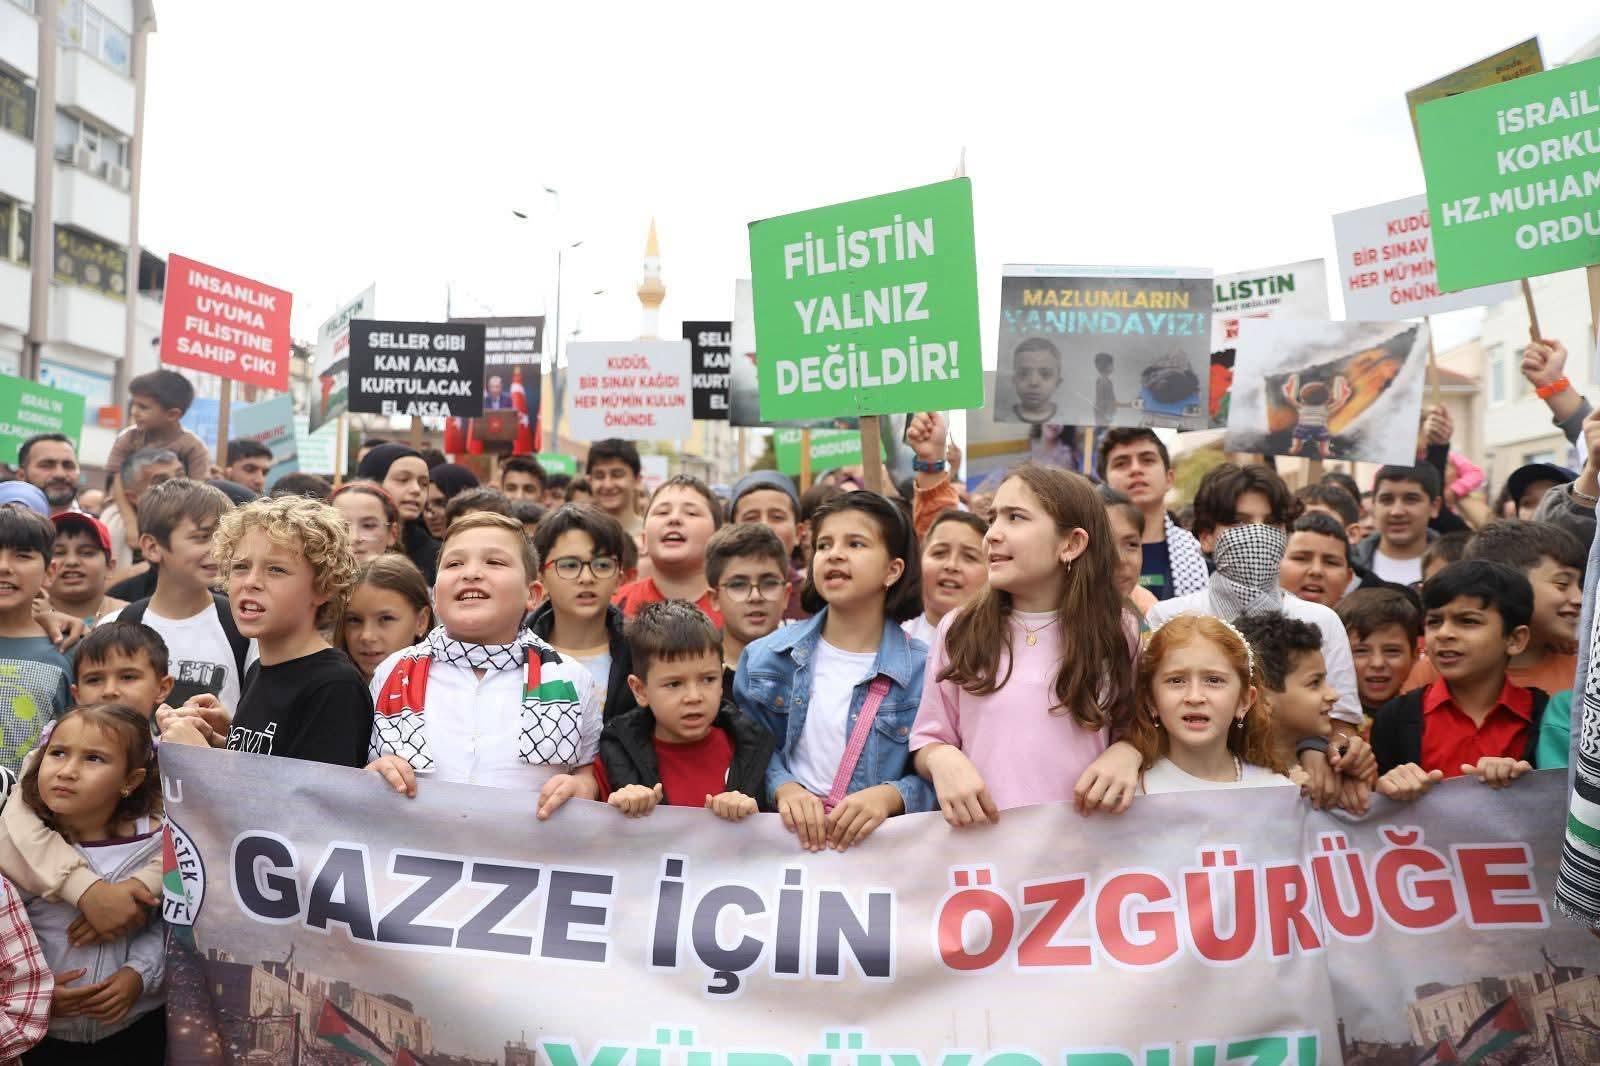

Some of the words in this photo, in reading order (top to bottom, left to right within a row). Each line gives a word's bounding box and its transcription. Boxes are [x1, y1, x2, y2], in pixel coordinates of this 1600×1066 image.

[1497, 128, 1600, 175] KORKU
[1515, 209, 1600, 249] ORDU
[784, 213, 935, 280] FİLİSTİN
[1353, 246, 1378, 266] BİR
[1382, 237, 1428, 261] SINAV
[1350, 271, 1379, 291] HER
[1390, 282, 1443, 305] ÖNÜN
[794, 281, 930, 335] YALNIZ
[1022, 289, 1190, 310] MAZLUMLARIN
[196, 295, 265, 330] UYUMA
[1003, 309, 1206, 336] YANINDAYIZ!
[368, 331, 430, 350] SELLER
[373, 355, 411, 372] KAN
[413, 356, 460, 374] AKSA
[775, 335, 960, 395] DEĞİLDİR!
[360, 377, 473, 397] KURTULACAK
[601, 375, 638, 388] SINAV
[404, 401, 453, 417] AKSA
[575, 396, 598, 409] HER
[645, 394, 686, 407] KULUN
[234, 835, 614, 964] GAZZE
[652, 858, 892, 995] İÇİN
